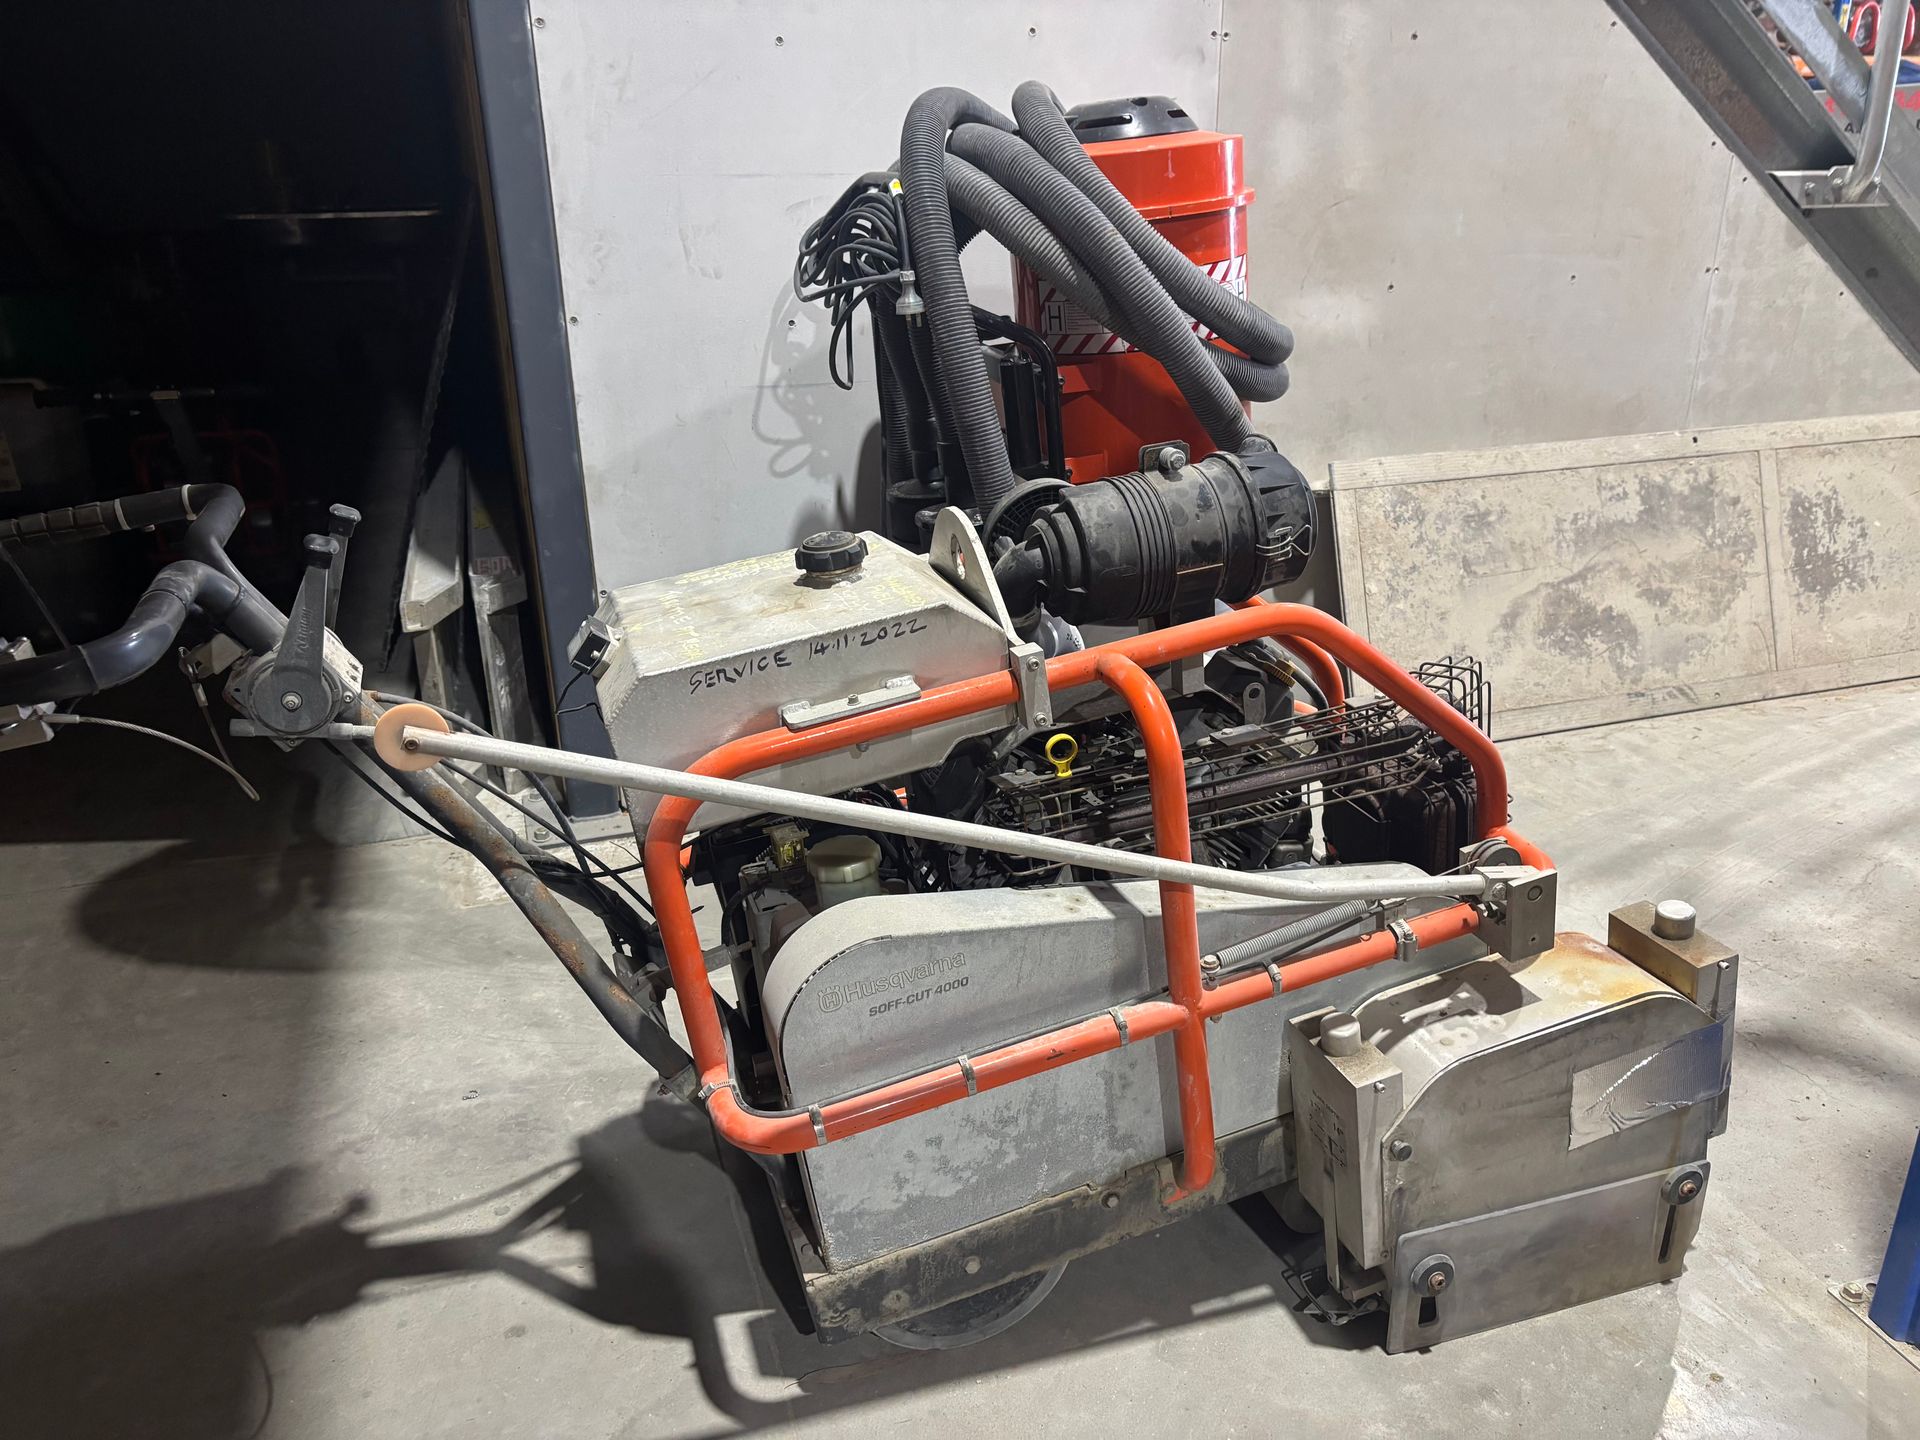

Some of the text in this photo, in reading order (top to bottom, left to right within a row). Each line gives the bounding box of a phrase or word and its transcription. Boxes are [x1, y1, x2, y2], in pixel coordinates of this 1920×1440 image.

[1048, 305, 1062, 332] H
[690, 650, 792, 695] SERVICE
[843, 952, 966, 1003] Husqvarna
[869, 976, 969, 1017] SOFF-CUT 4000
